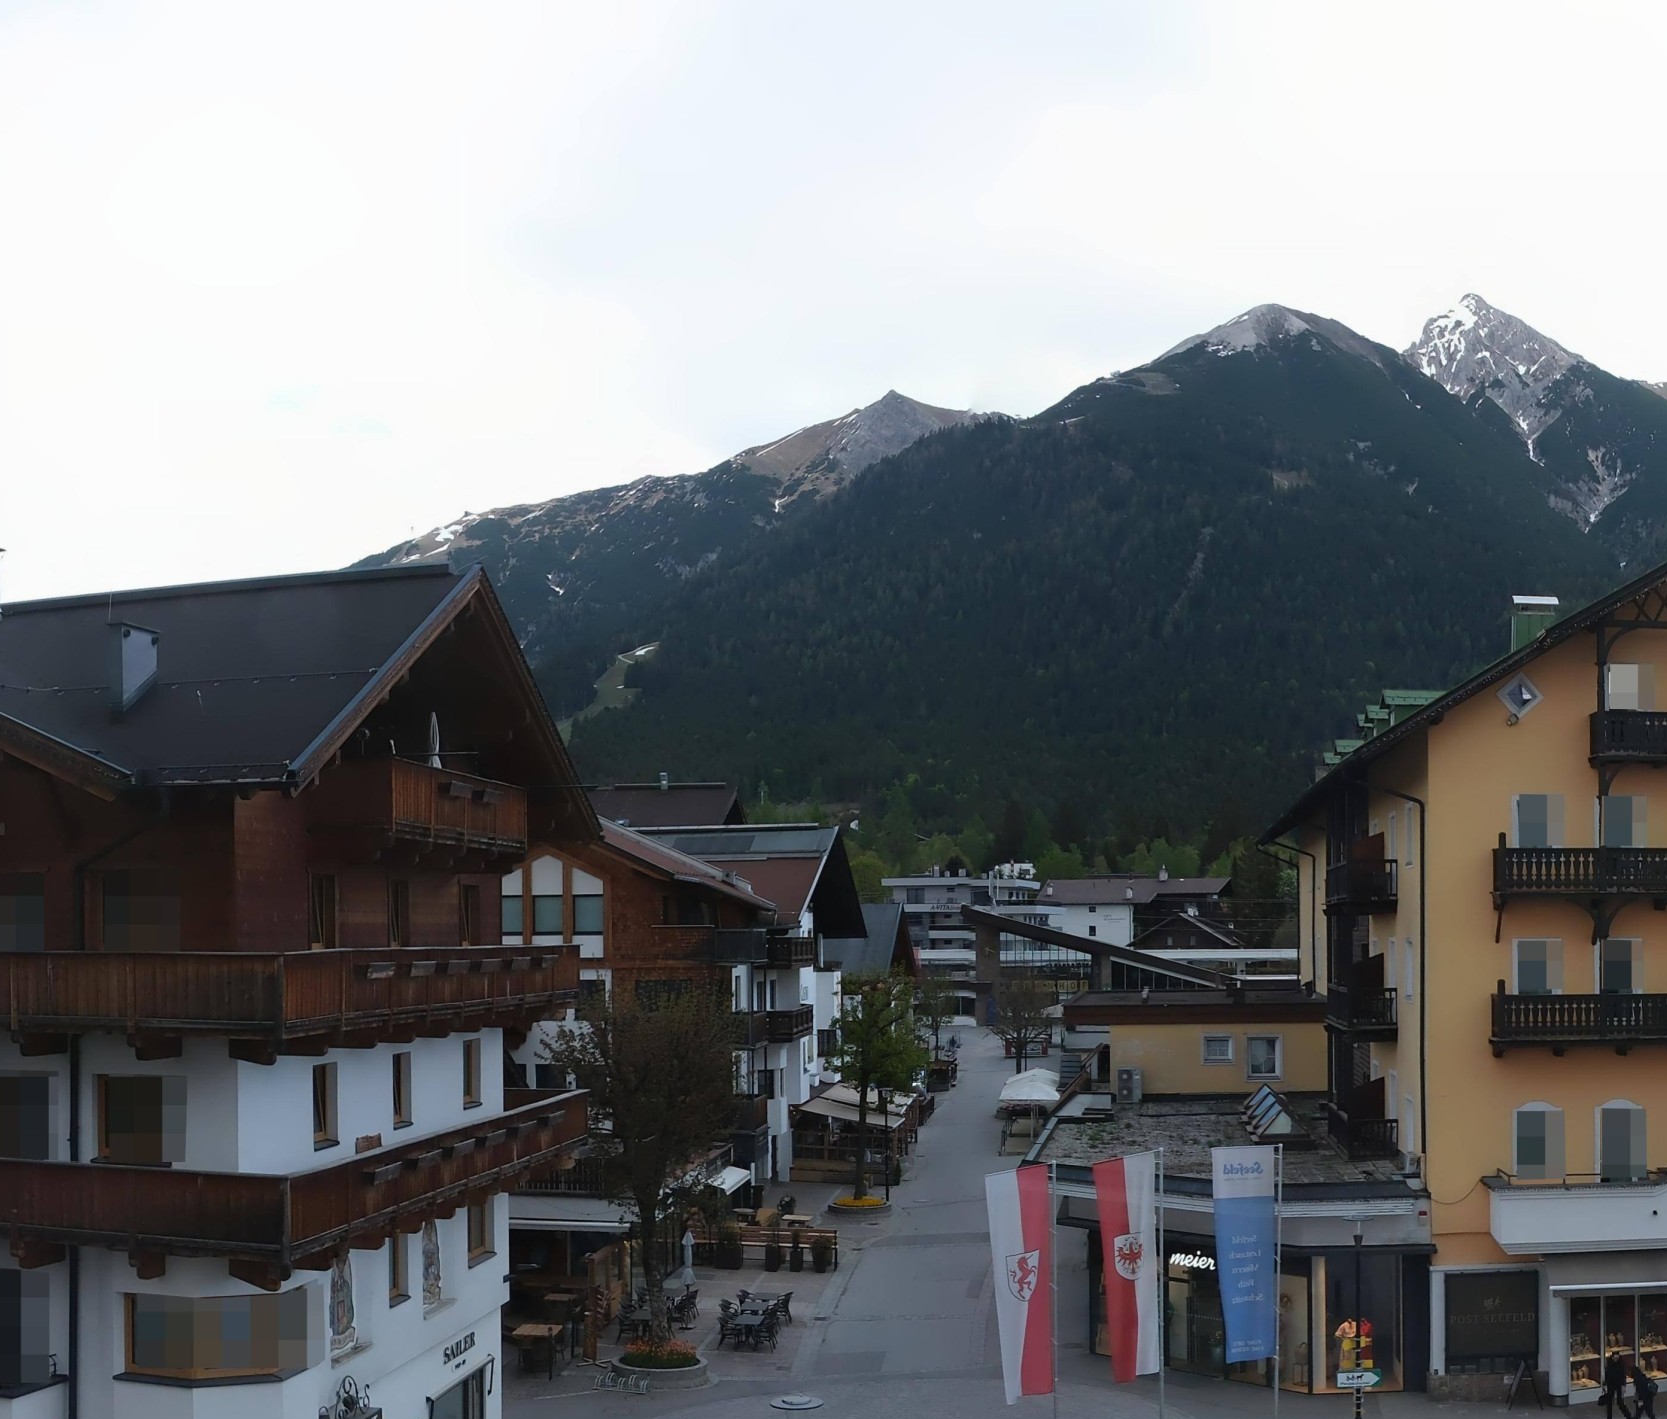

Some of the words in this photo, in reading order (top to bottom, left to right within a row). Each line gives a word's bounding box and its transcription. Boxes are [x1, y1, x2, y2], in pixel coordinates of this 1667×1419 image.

[1169, 1250, 1217, 1271] meier
[1450, 1314, 1480, 1325] POST
[1483, 1312, 1535, 1324] SEEFELD
[443, 1331, 475, 1365] SAILER
